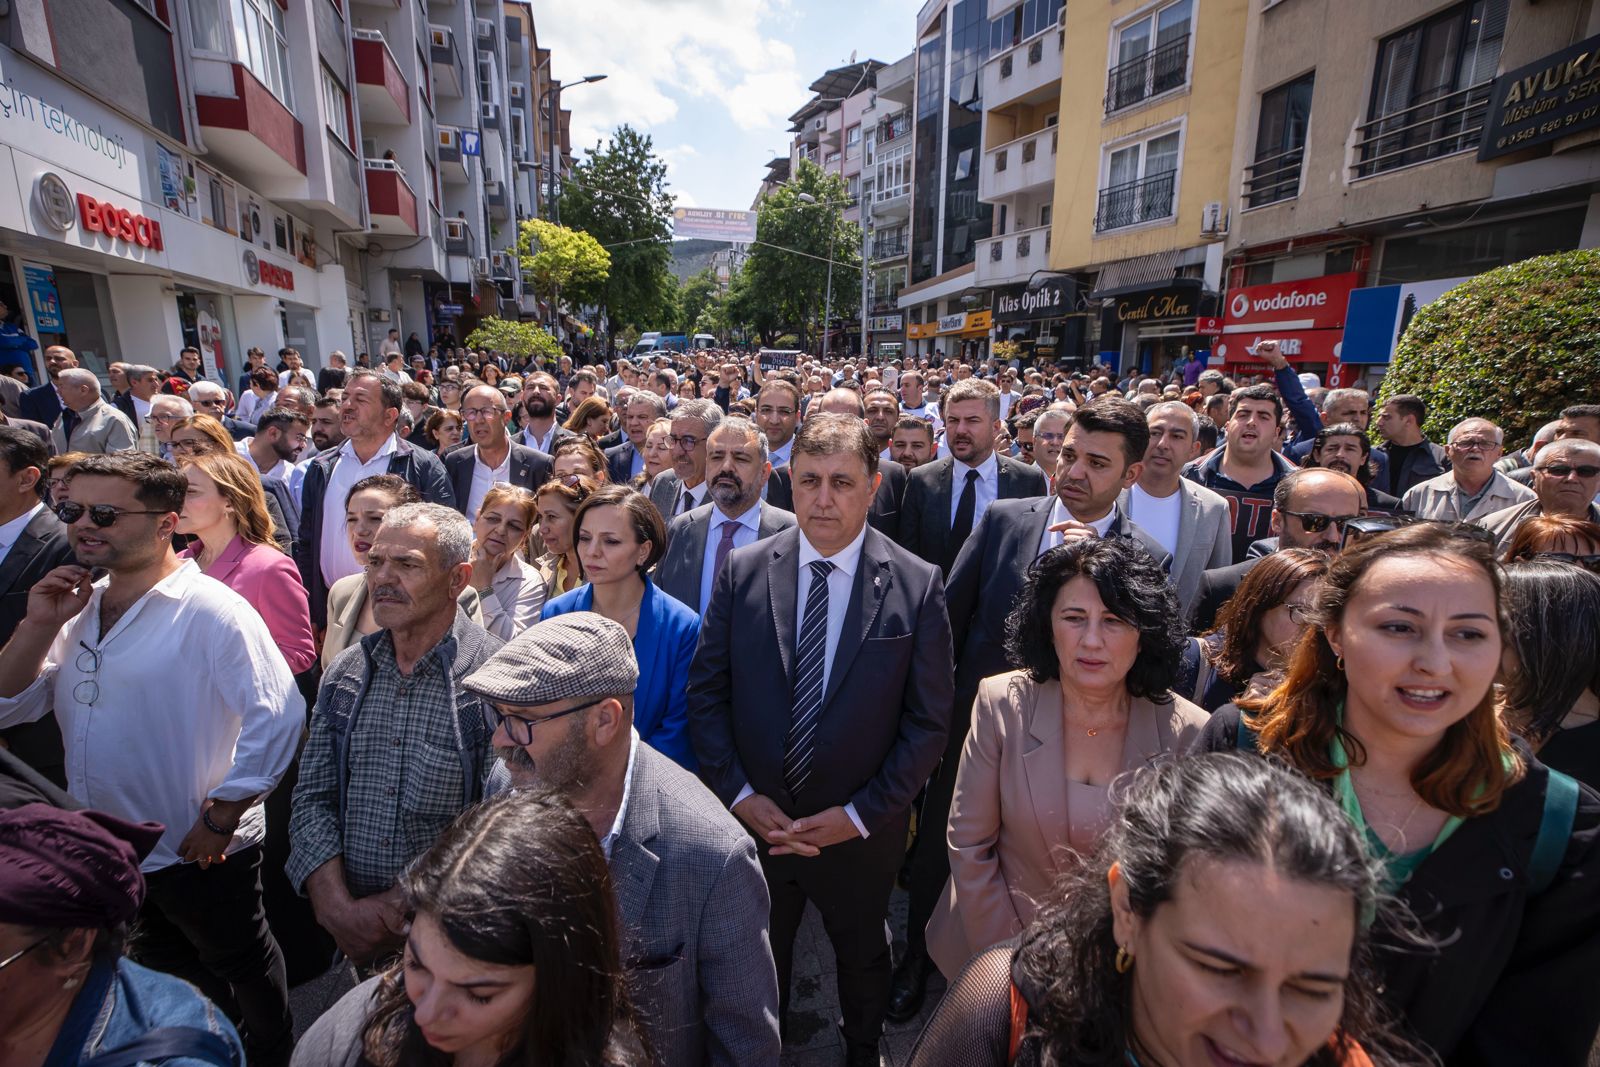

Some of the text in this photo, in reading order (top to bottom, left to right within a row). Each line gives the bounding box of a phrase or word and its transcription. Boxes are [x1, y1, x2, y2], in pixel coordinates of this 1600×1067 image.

[40, 97, 126, 169] teknoloji
[76, 192, 164, 252] BOSCH
[998, 287, 1060, 314] Klas Optik 2
[1153, 295, 1190, 317] Men
[1253, 290, 1327, 312] vodafone
